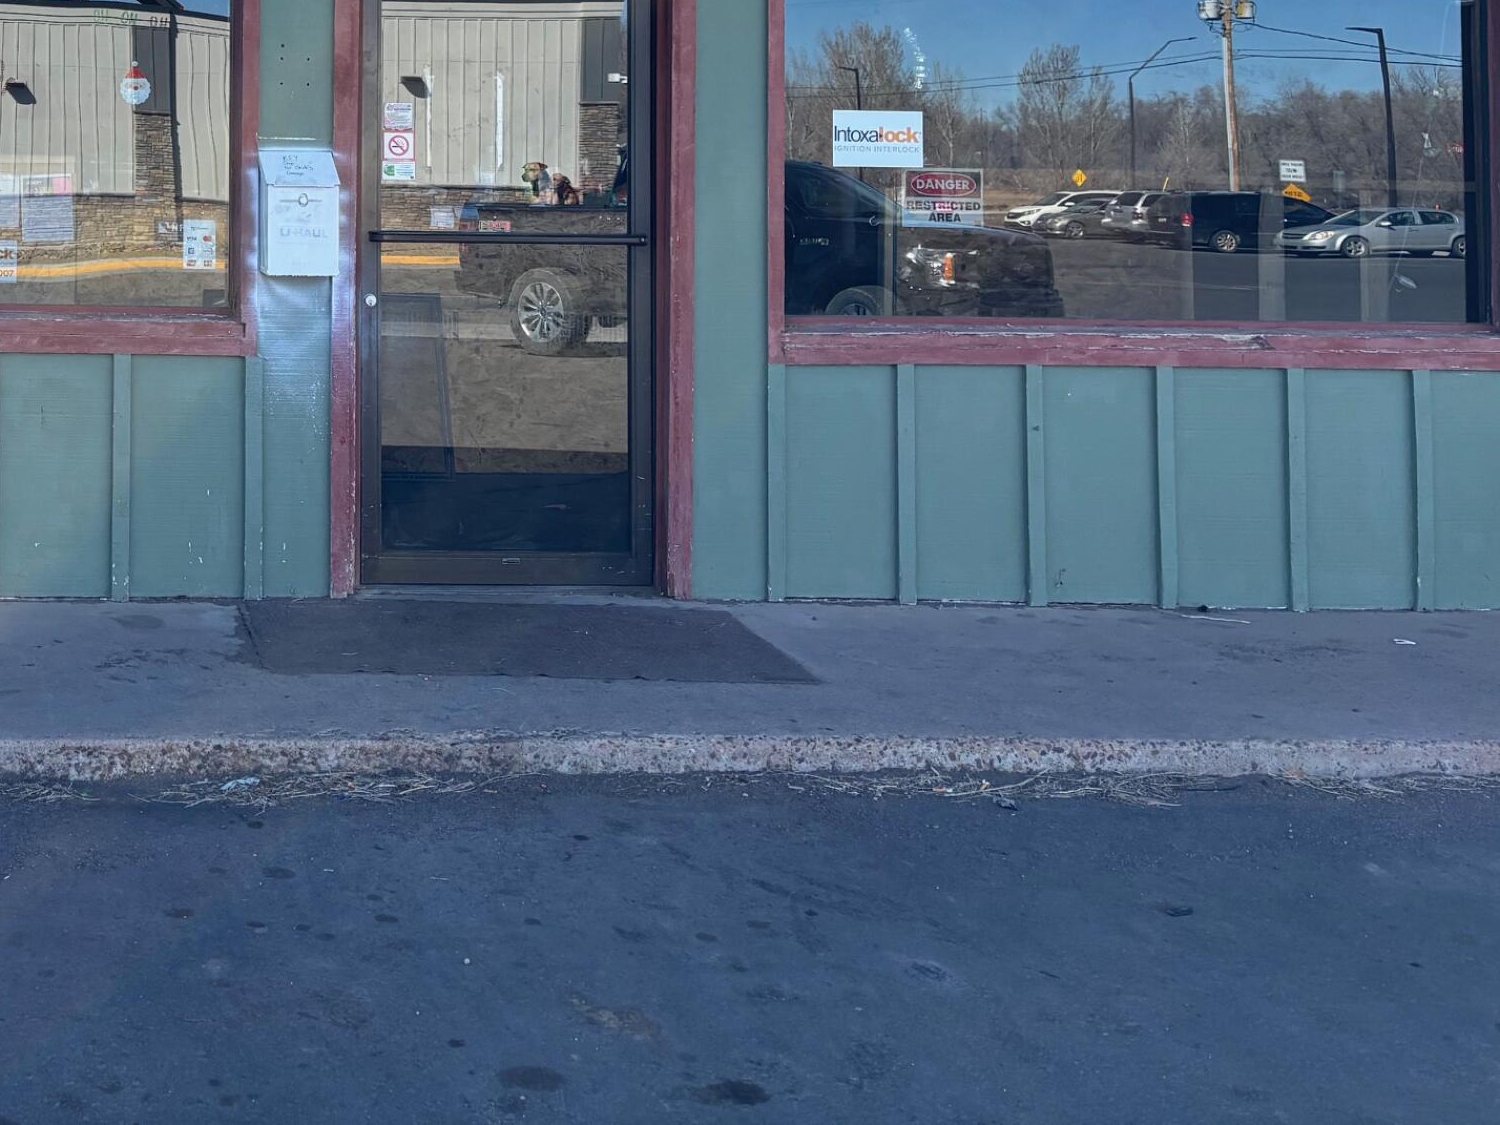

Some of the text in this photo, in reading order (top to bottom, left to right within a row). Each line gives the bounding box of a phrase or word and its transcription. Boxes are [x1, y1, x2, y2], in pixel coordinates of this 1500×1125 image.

[834, 125, 920, 143] Intoxalock
[835, 145, 920, 153] IGNITION INTERLOCK
[916, 179, 970, 190] DANGER
[906, 200, 981, 211] RESTRICTED
[929, 212, 961, 223] AREA
